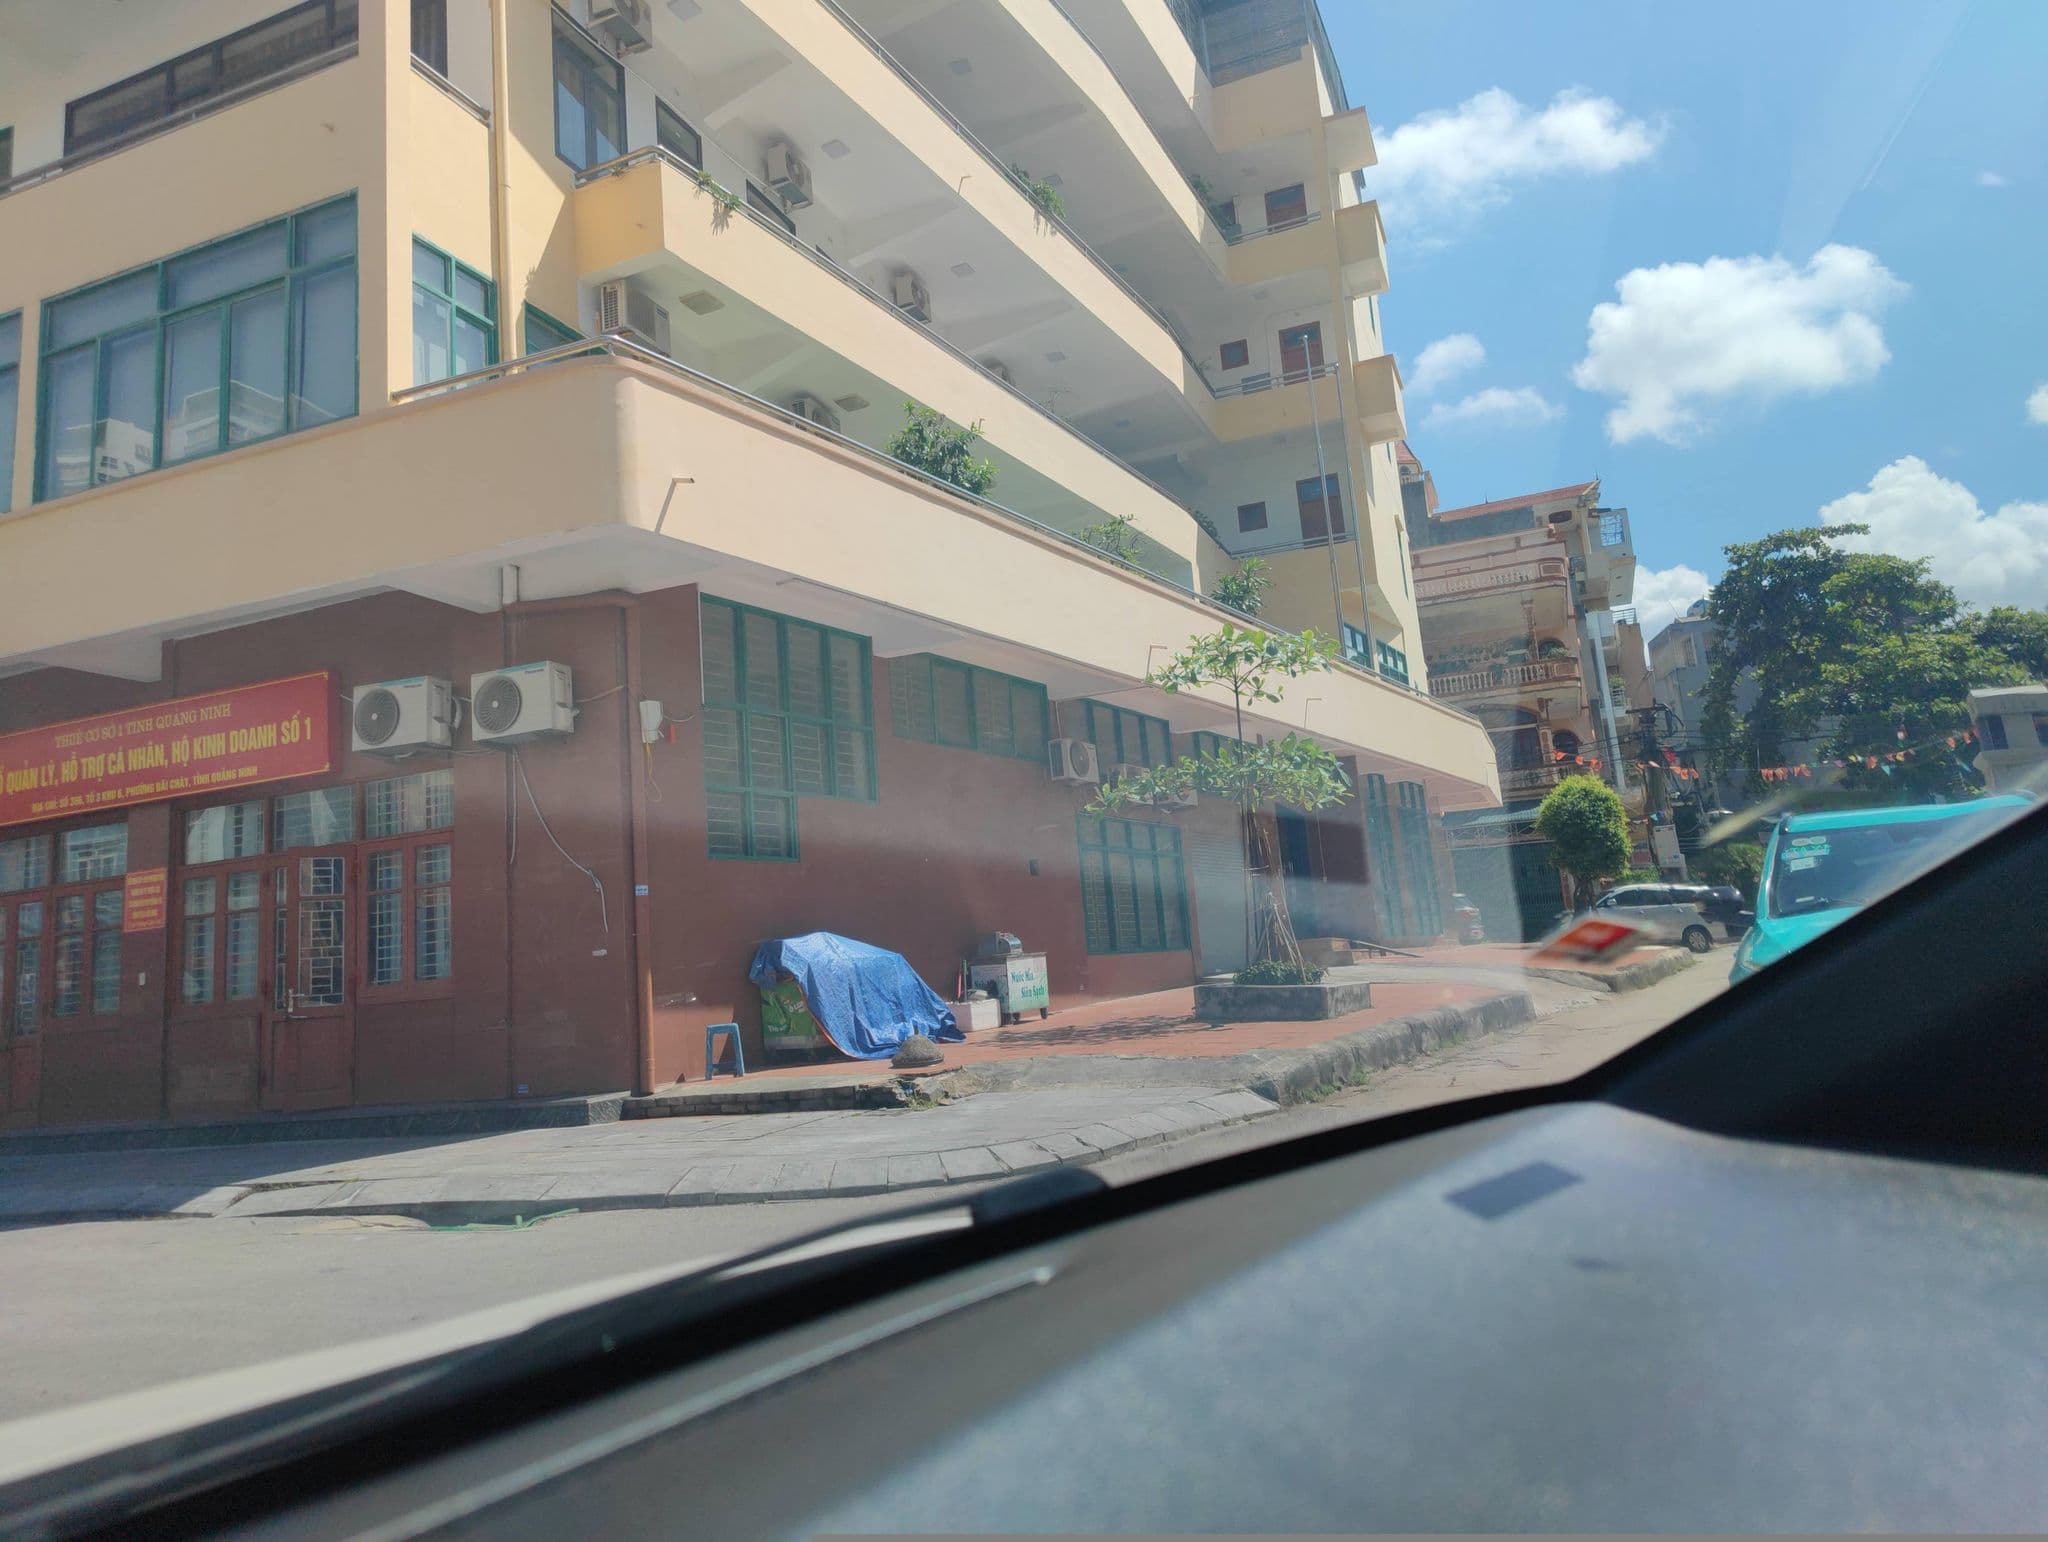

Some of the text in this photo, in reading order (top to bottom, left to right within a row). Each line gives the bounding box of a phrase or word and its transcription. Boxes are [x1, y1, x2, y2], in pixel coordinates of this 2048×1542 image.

[156, 708, 196, 729] QUẢNG
[199, 703, 231, 721] NINH
[82, 753, 105, 782] TRỢ
[108, 745, 125, 775] CÁ
[128, 741, 168, 771] NHÂN,
[172, 735, 189, 767] HỘ
[193, 732, 226, 760] KINH
[229, 723, 277, 753] DOANH
[281, 709, 300, 744] SỐ
[304, 716, 312, 740] 1
[211, 765, 237, 781] QUẢNG
